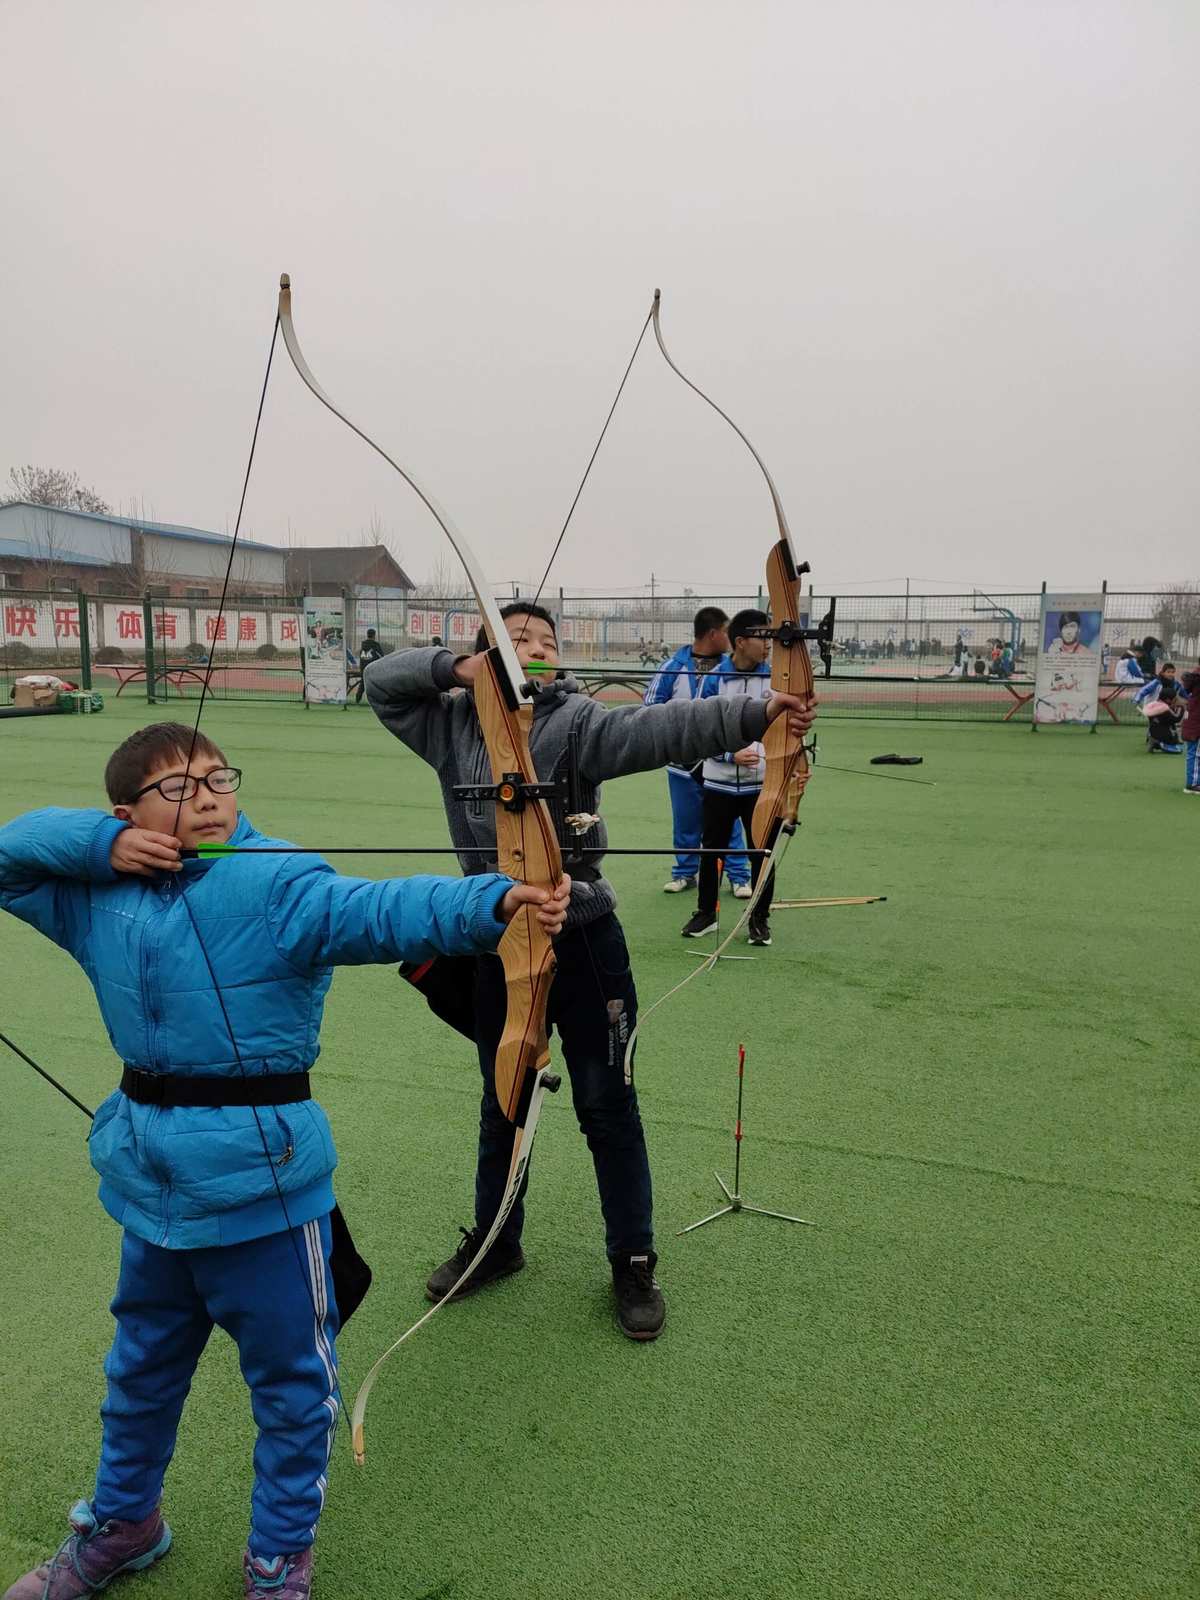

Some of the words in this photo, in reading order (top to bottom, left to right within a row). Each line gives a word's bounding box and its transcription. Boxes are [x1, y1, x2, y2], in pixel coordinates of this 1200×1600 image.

[5, 605, 80, 638] 快乐
[117, 610, 177, 640] 体育
[205, 615, 257, 641] 健康
[281, 618, 298, 641] 成
[411, 612, 442, 635] 创造
